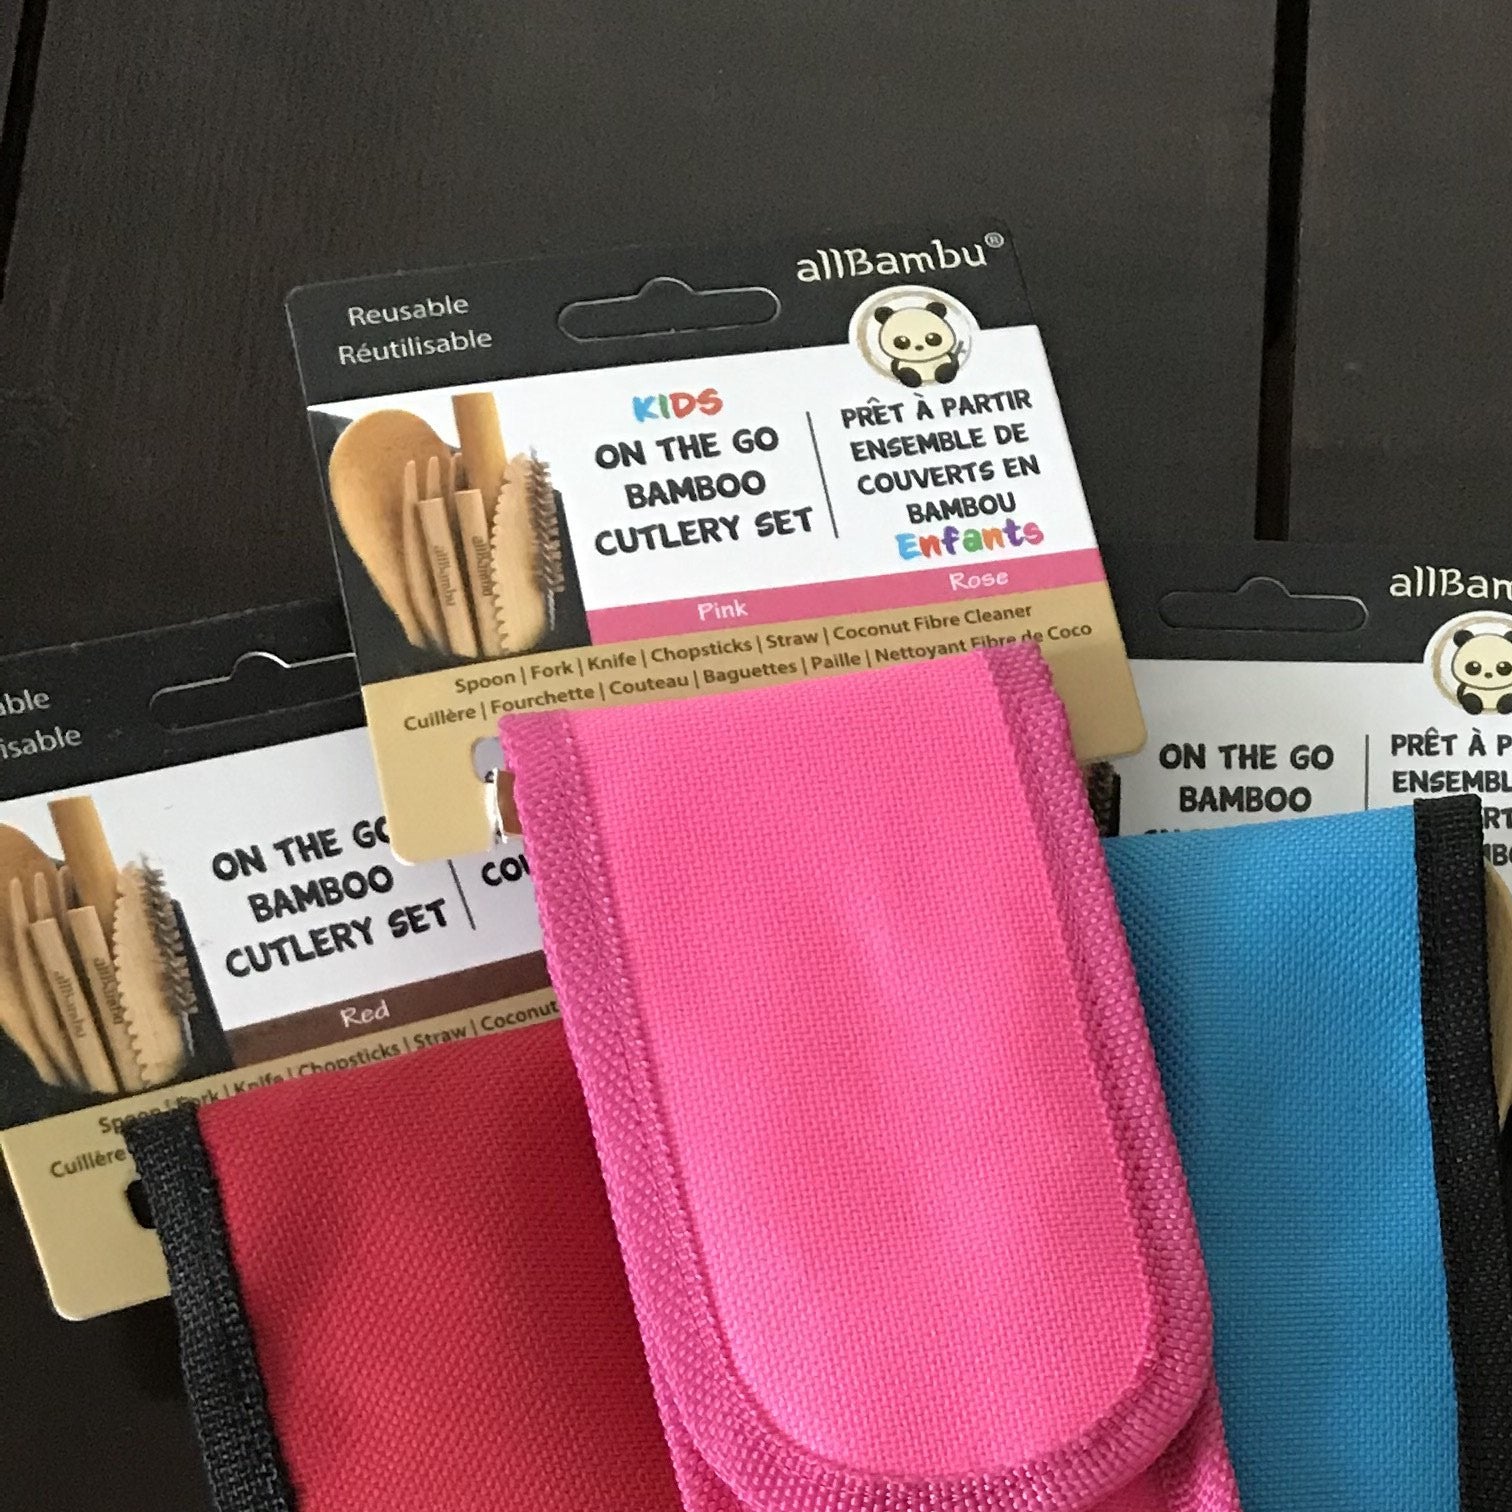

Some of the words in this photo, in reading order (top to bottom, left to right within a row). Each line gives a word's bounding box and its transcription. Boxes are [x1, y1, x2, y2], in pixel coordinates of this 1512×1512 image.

[347, 295, 469, 326] Reusable
[338, 330, 492, 365] Réutilisable
[632, 388, 723, 422] KIDS
[841, 397, 904, 428] PRÊT
[913, 392, 934, 420] À
[941, 389, 1032, 417] PARTIR
[595, 440, 647, 469] ON
[656, 432, 721, 461] THE
[733, 426, 779, 453] GO
[850, 427, 986, 461] ENSEMBLE
[994, 423, 1029, 444] DE
[624, 470, 766, 509] BAMBOO
[858, 461, 995, 495] COUVERTS
[1002, 455, 1041, 478] EN
[906, 492, 1016, 524] BAMBOU
[595, 515, 740, 556] CUTLERY
[755, 506, 813, 537] SET
[895, 518, 1044, 560] Enfants
[949, 571, 1009, 591] Rose
[698, 599, 748, 621] Pink
[454, 672, 516, 694] Spoon
[531, 661, 573, 680] Fork
[588, 653, 637, 671] Knife
[651, 638, 753, 663] Chopsticks
[766, 630, 818, 649] Straw
[834, 620, 911, 641] Coconut
[914, 614, 961, 632] Fibre
[964, 604, 1032, 625] Cleaner
[404, 707, 476, 731] Cuillère
[491, 687, 595, 715] Fourchette
[609, 674, 689, 695] Couteau
[704, 655, 797, 686] Baguettes
[811, 652, 861, 671] Paille
[875, 640, 968, 662] Nettoyant
[1048, 624, 1092, 641] Coco
[0, 726, 82, 759] isable
[1159, 743, 1206, 770] ON
[1218, 744, 1277, 770] THE
[1289, 744, 1334, 770] GO
[1391, 726, 1457, 756] PRÊT
[1468, 727, 1486, 756] À
[1179, 785, 1312, 812] BAMBOO
[212, 845, 267, 881] ON
[273, 828, 342, 867] THE
[248, 865, 394, 923] BAMBOO
[226, 916, 374, 977] CUTLERY
[388, 899, 447, 938] SET
[340, 1000, 390, 1027] Red
[414, 1025, 467, 1049] Straw
[481, 1001, 559, 1031] Coconut
[50, 1148, 126, 1177] Cuillère
